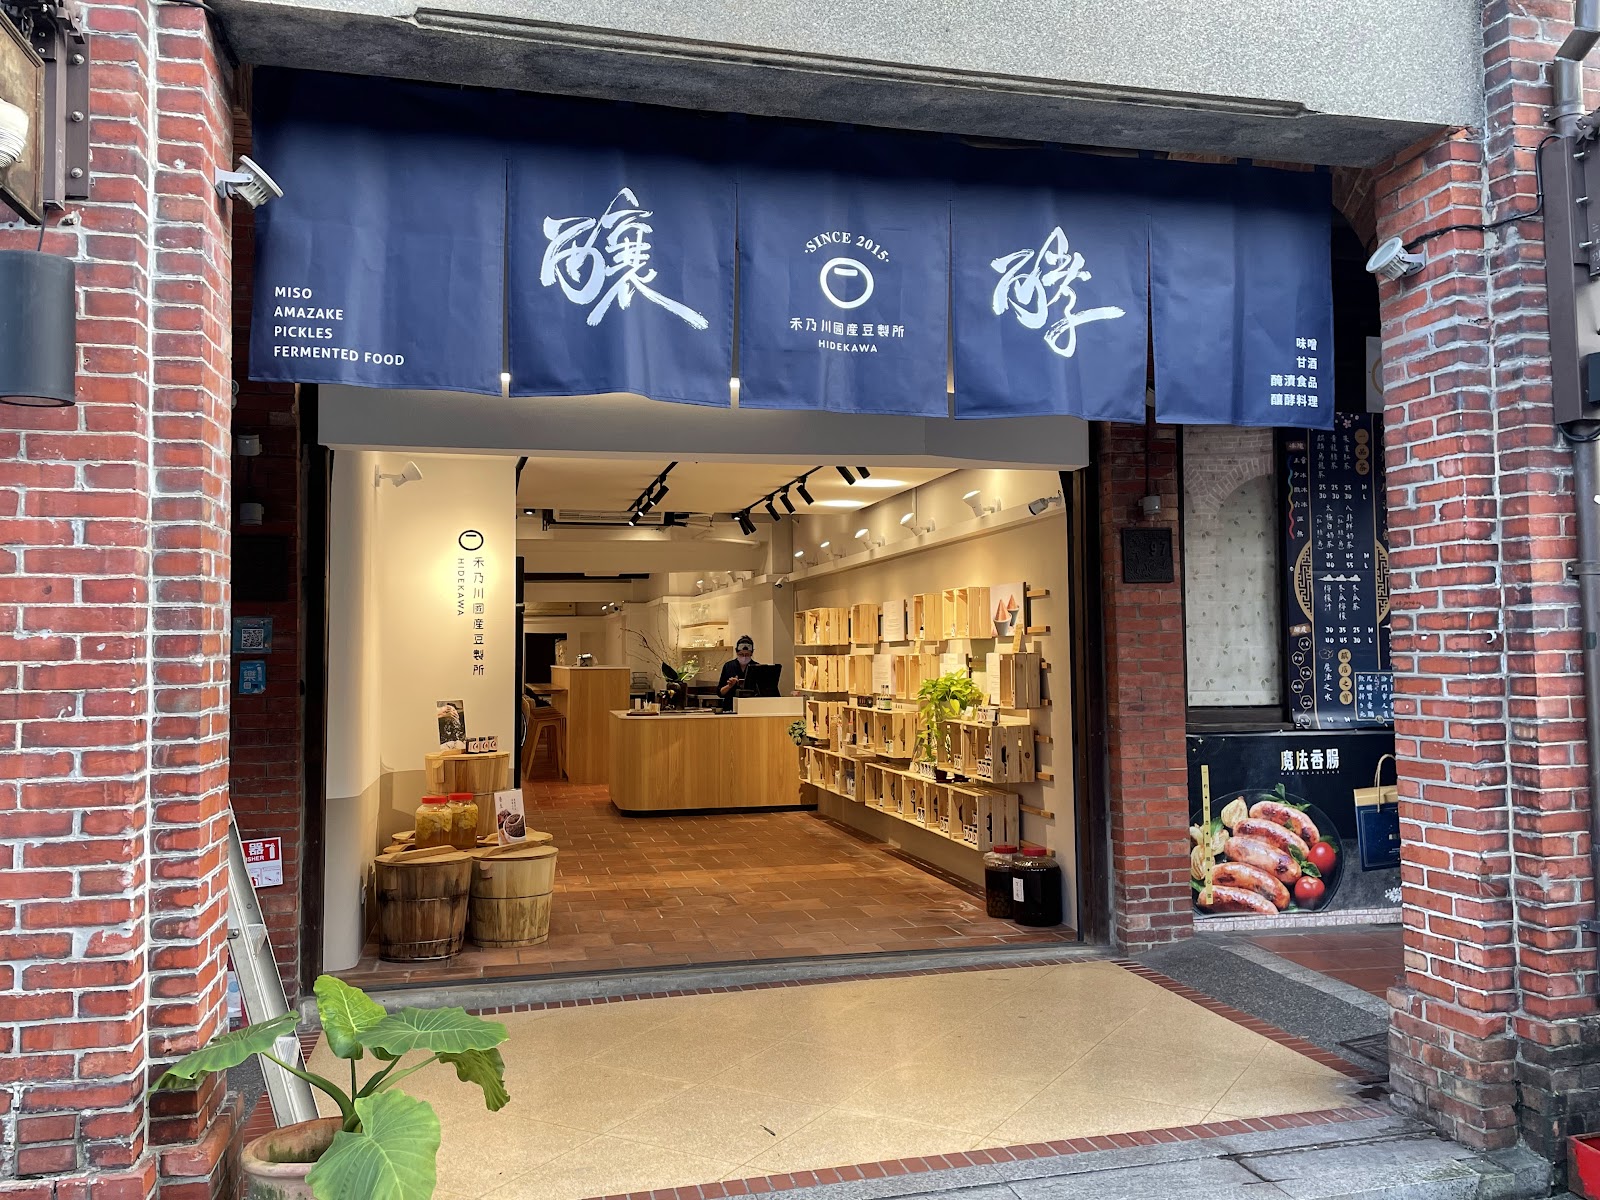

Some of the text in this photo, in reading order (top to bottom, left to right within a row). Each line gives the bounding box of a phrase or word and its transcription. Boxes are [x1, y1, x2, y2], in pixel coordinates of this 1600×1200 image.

[806, 231, 852, 253] SINCE
[540, 186, 709, 330] 釀
[274, 286, 313, 300] MISO
[990, 226, 1126, 358] 酵
[274, 305, 345, 321] AMAZAKE
[274, 325, 334, 340] PICKLES
[818, 339, 878, 353] HIDEKAWA
[1296, 337, 1318, 351] 味噌
[274, 345, 405, 366] FERMENTED FOOD
[1296, 356, 1318, 370] 甘酒
[457, 558, 465, 616] HIDEKAWA
[1280, 748, 1340, 771] 魔法香腸
